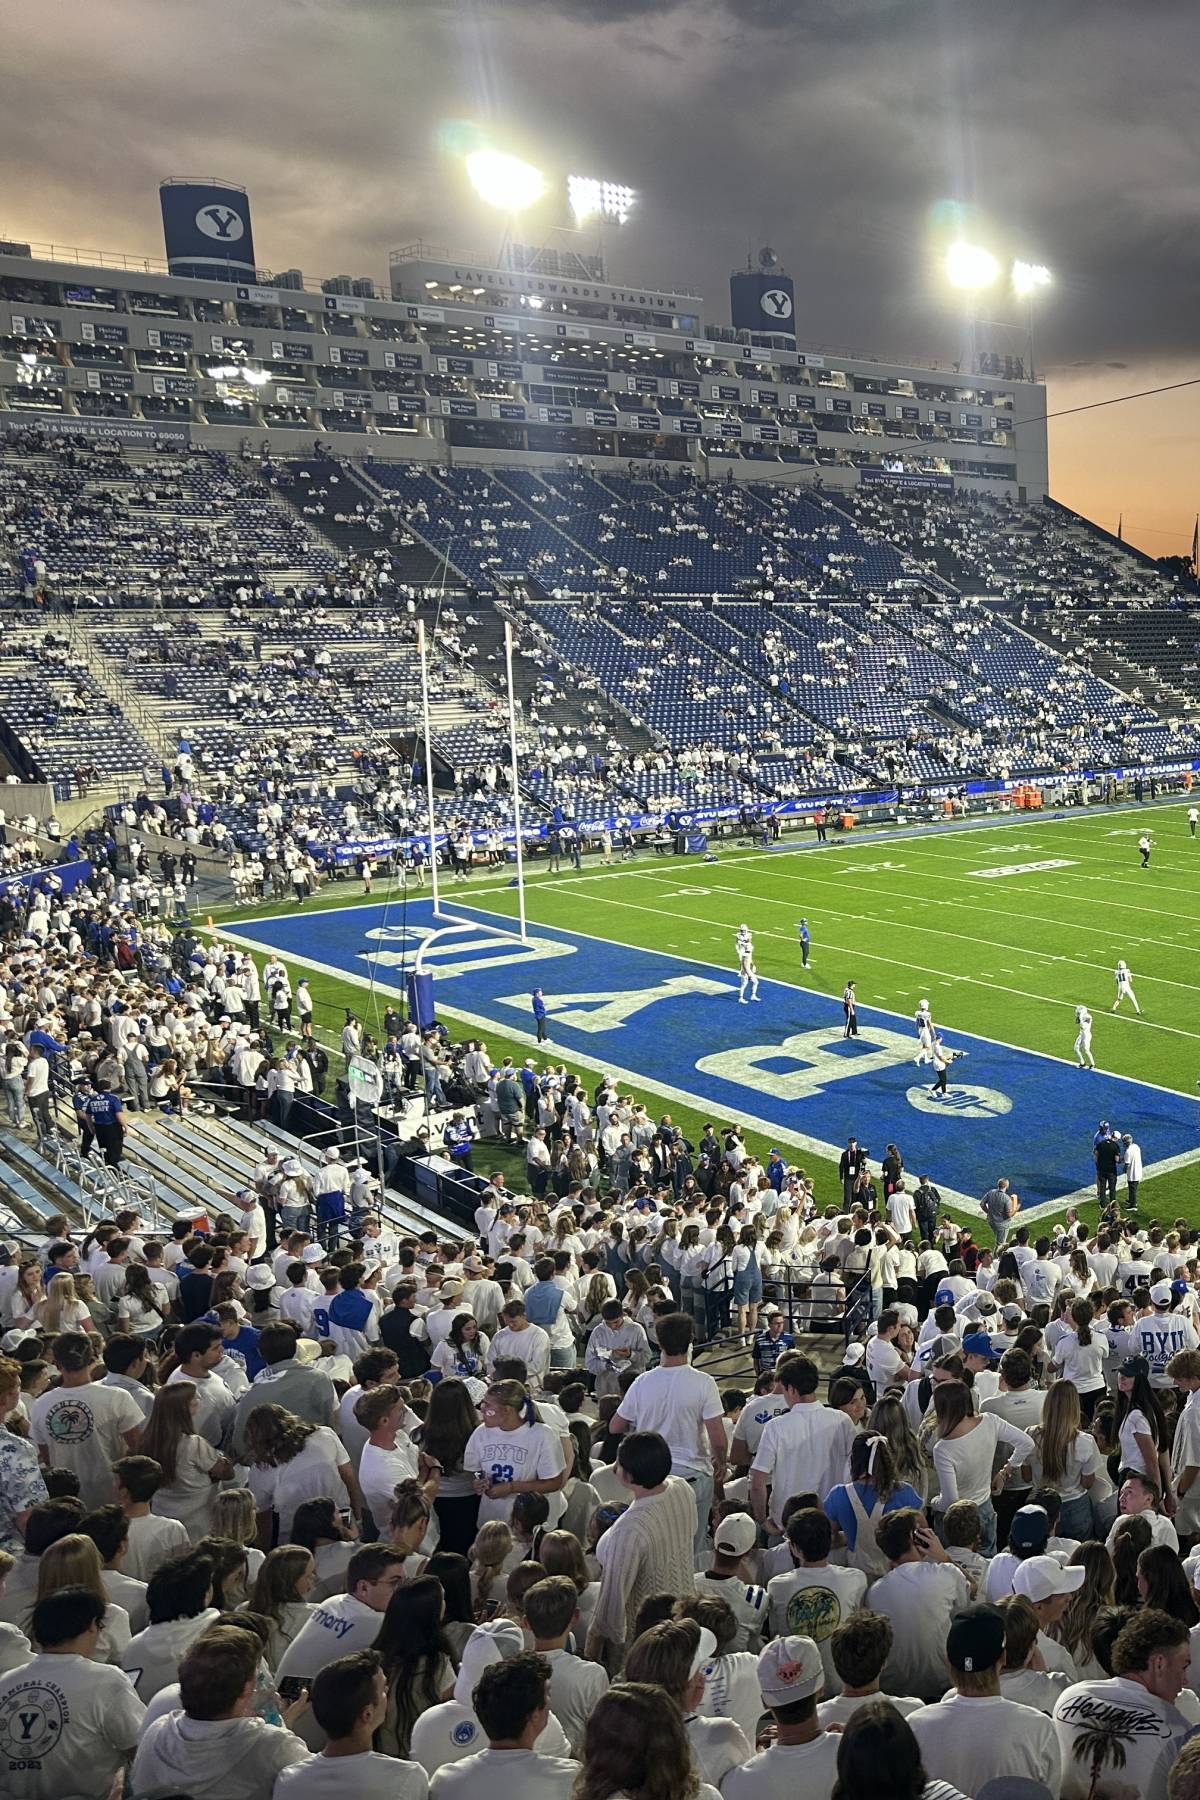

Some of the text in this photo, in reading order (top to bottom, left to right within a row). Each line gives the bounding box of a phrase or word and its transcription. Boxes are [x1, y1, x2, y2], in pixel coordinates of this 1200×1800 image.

[455, 272, 677, 308] LAVELL EDWARDS STADIUM
[9, 422, 28, 431] Text
[61, 425, 86, 435] ISSUE
[99, 428, 143, 438] LOCATION
[145, 431, 157, 439] TO
[1145, 763, 1193, 775] COUGARS
[1141, 1331, 1184, 1354] BYU
[482, 1444, 529, 1464] BYU
[491, 1464, 514, 1484] 23
[46, 1680, 71, 1725] CHAMPION
[19, 1712, 39, 1739] Y
